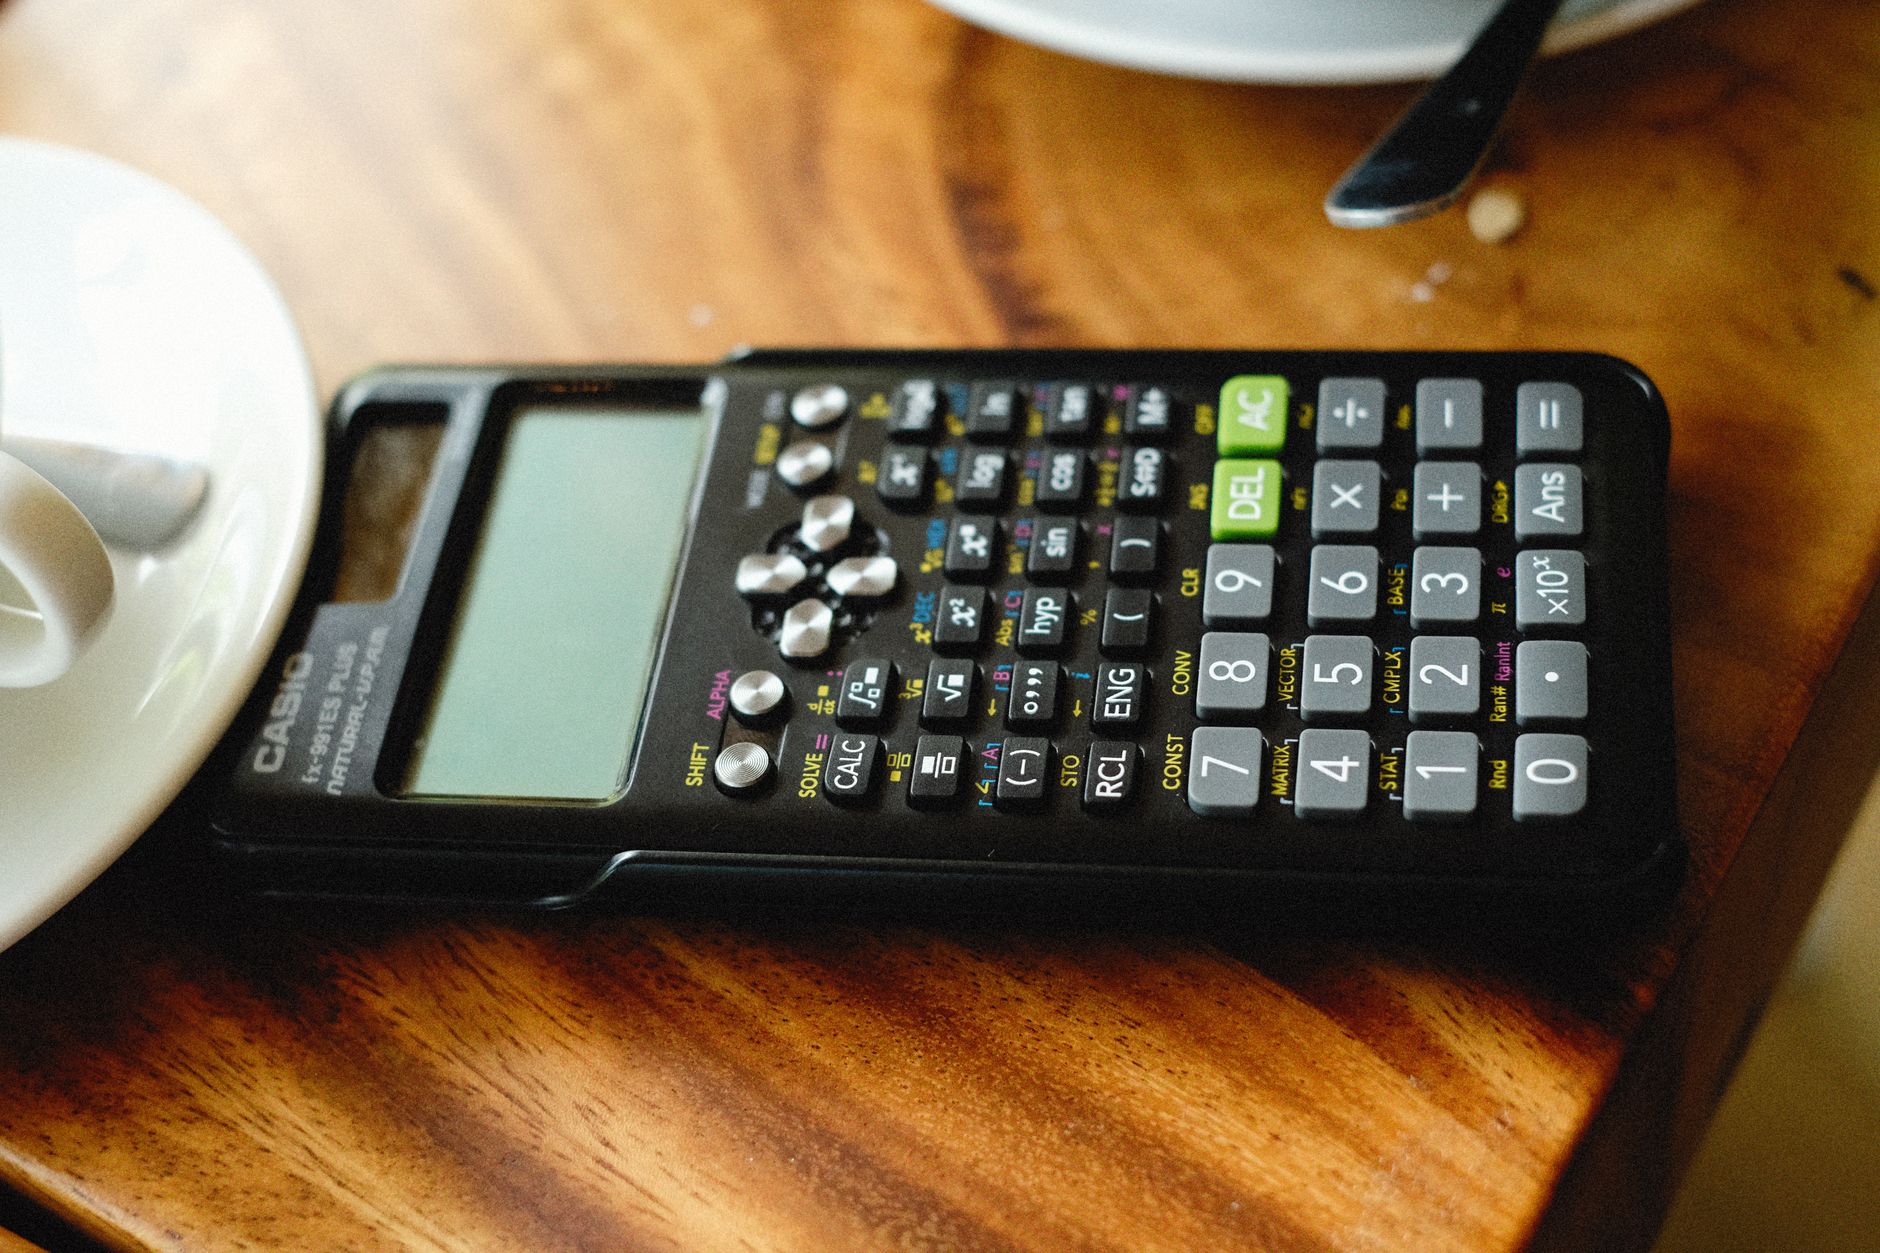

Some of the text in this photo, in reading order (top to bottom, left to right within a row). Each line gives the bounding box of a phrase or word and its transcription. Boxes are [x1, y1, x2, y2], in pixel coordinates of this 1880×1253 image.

[1237, 389, 1273, 431] AC
[1539, 399, 1560, 429] =
[966, 454, 1005, 489] log
[1050, 454, 1078, 491] cos
[1228, 466, 1264, 520] DEL
[1427, 483, 1463, 511] +
[1531, 471, 1565, 522] Ans
[1041, 528, 1069, 558] sin
[1181, 568, 1199, 597] CLR
[1215, 569, 1262, 592] 9
[1321, 571, 1368, 594] 6
[1387, 567, 1405, 605] BASE
[1421, 573, 1469, 595] 3
[913, 591, 935, 622] DEC
[1025, 597, 1060, 634] hyp
[1081, 609, 1098, 625] %
[995, 618, 1014, 647] Abs
[328, 641, 358, 692] PLUS
[994, 671, 1010, 680] B
[1172, 650, 1192, 695] CONV
[1209, 660, 1256, 683] 8
[1277, 648, 1296, 702] VECTOR
[1313, 663, 1363, 685] 5
[1383, 650, 1402, 703] CMPLX
[1419, 664, 1469, 686] 2
[1495, 642, 1513, 681] RanInt
[706, 670, 731, 720] ALPHA
[1104, 668, 1136, 718] ENG
[1490, 686, 1507, 722] Ran#
[254, 651, 313, 773] CASIO
[685, 742, 710, 786] SHIFT
[834, 740, 866, 789] CALC
[982, 748, 999, 760] A
[1060, 754, 1080, 787] STO
[1162, 733, 1184, 790] CONST
[1201, 755, 1250, 777] 7
[1271, 745, 1291, 796] MATRIX
[1310, 755, 1360, 782] 4
[1379, 752, 1398, 790] STAT
[1526, 758, 1578, 784] 0
[799, 753, 824, 798] SOLVE
[1095, 750, 1127, 798] RCL
[1415, 765, 1467, 779] 1
[1489, 760, 1507, 789] Rnd
